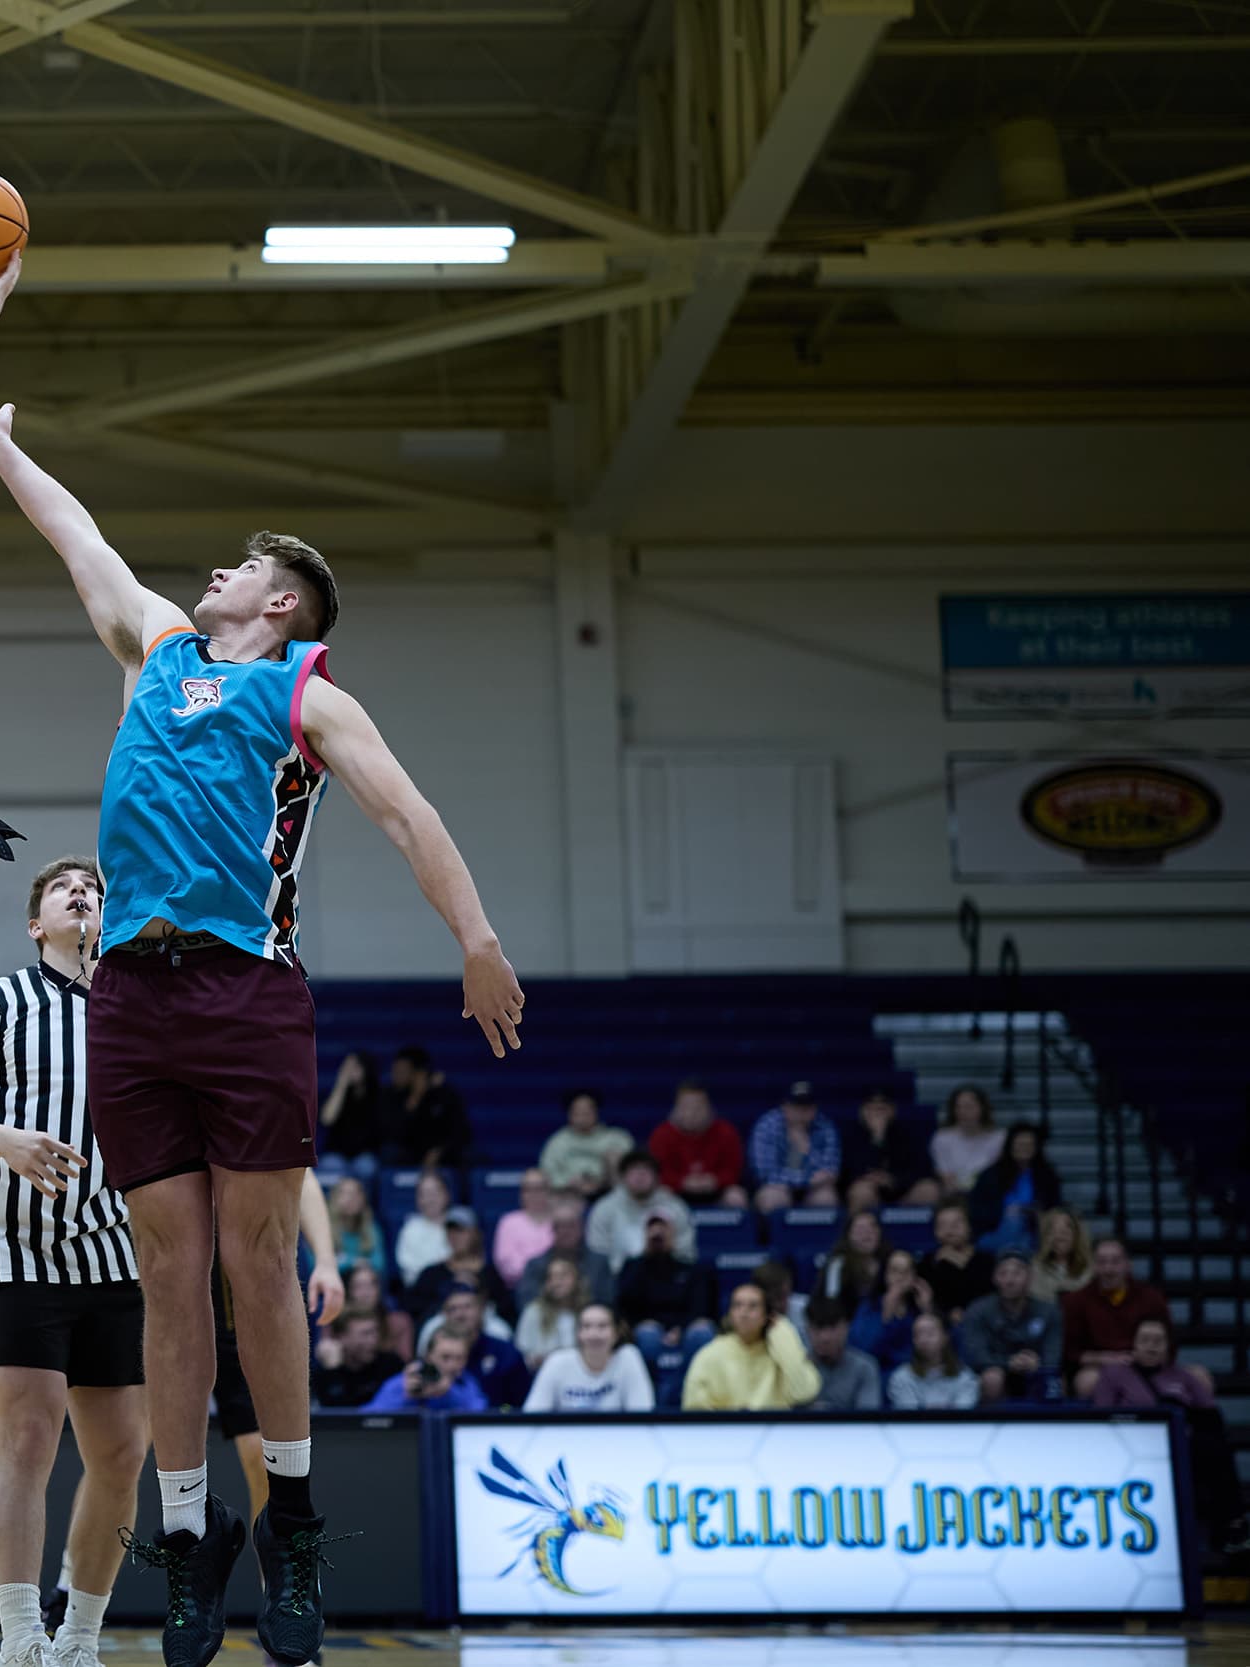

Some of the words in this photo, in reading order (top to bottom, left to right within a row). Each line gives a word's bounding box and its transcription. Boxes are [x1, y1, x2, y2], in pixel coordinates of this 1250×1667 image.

[987, 602, 1107, 631] Keeping
[1116, 600, 1232, 627] athletes
[1018, 636, 1047, 660] at
[1055, 633, 1122, 657] their
[644, 1480, 885, 1556] YELLOW
[896, 1478, 1160, 1555] JACKETS
